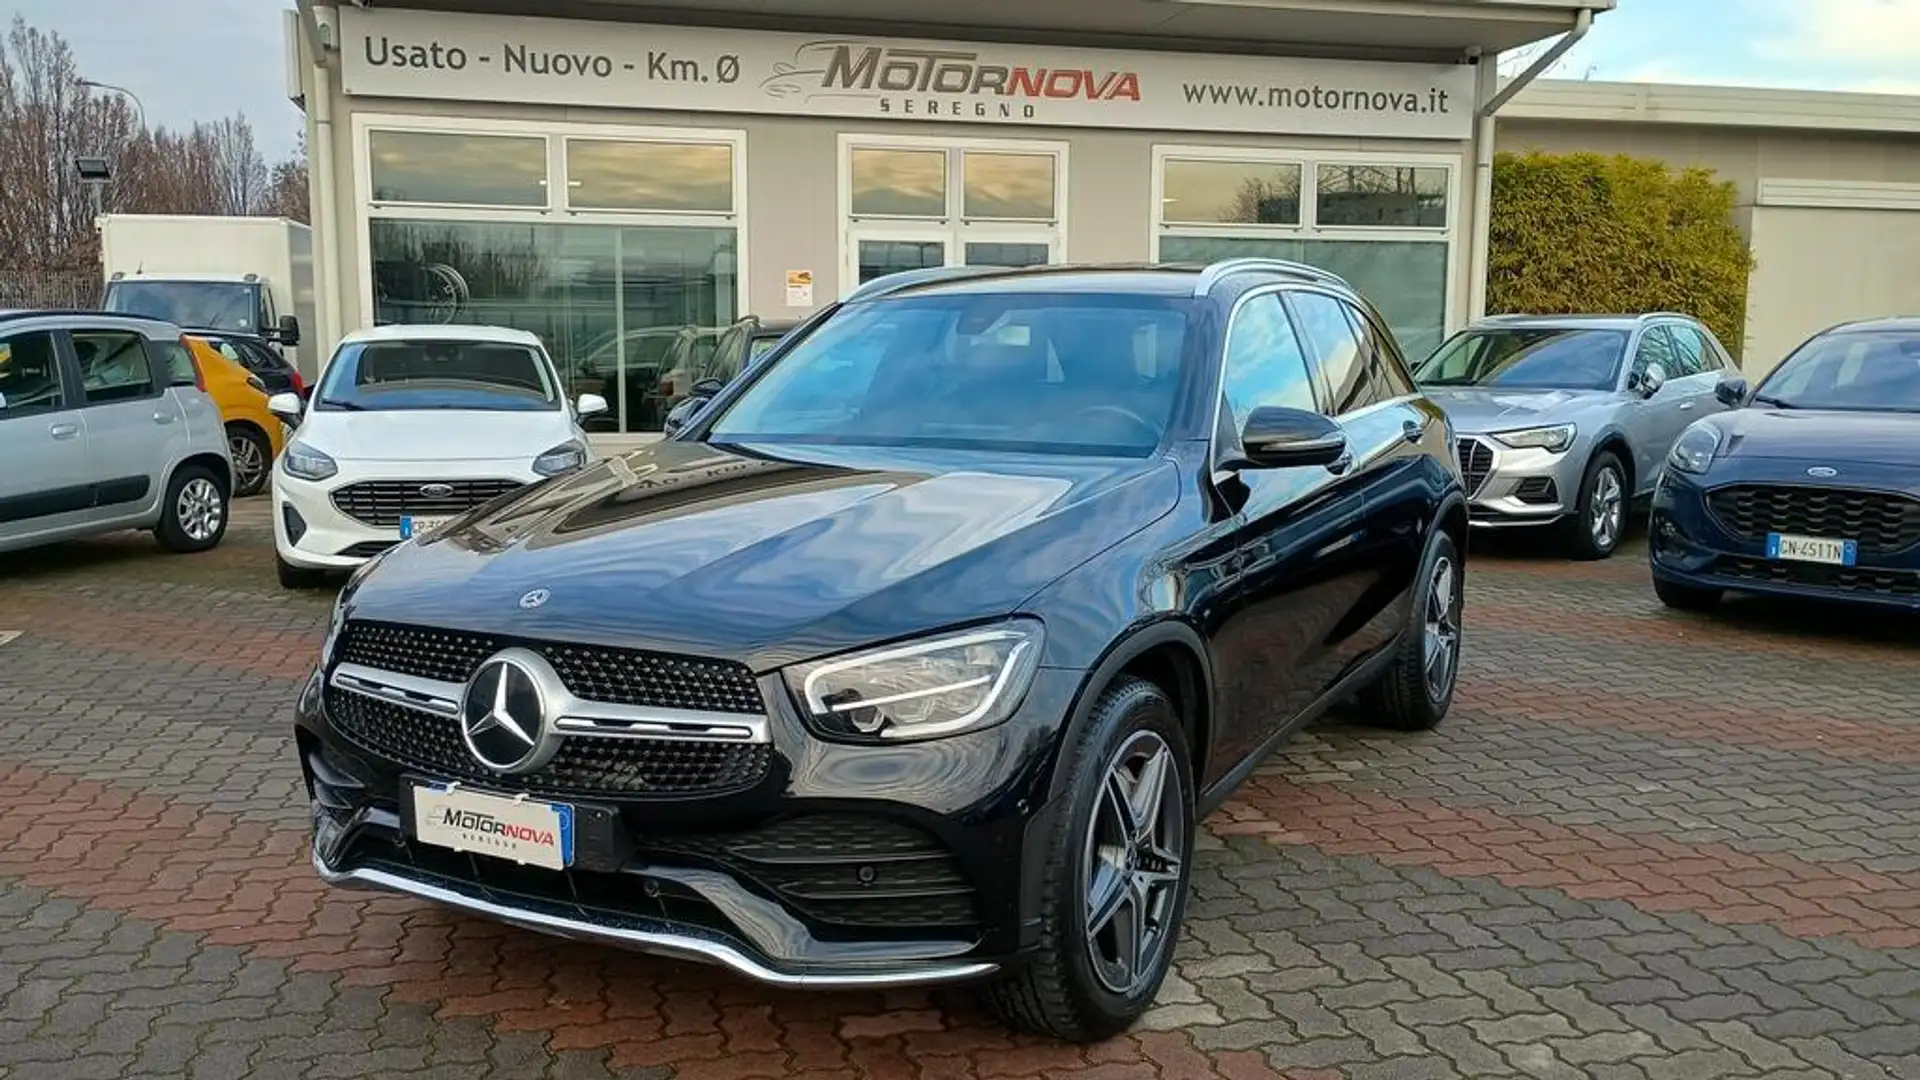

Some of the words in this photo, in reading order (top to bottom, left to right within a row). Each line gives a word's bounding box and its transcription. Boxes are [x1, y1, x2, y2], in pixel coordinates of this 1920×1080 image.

[365, 35, 467, 70] Usato
[503, 43, 613, 78] Nuovo
[880, 98, 1034, 119] SEREGNO
[1183, 83, 1449, 113] www.motornova.it
